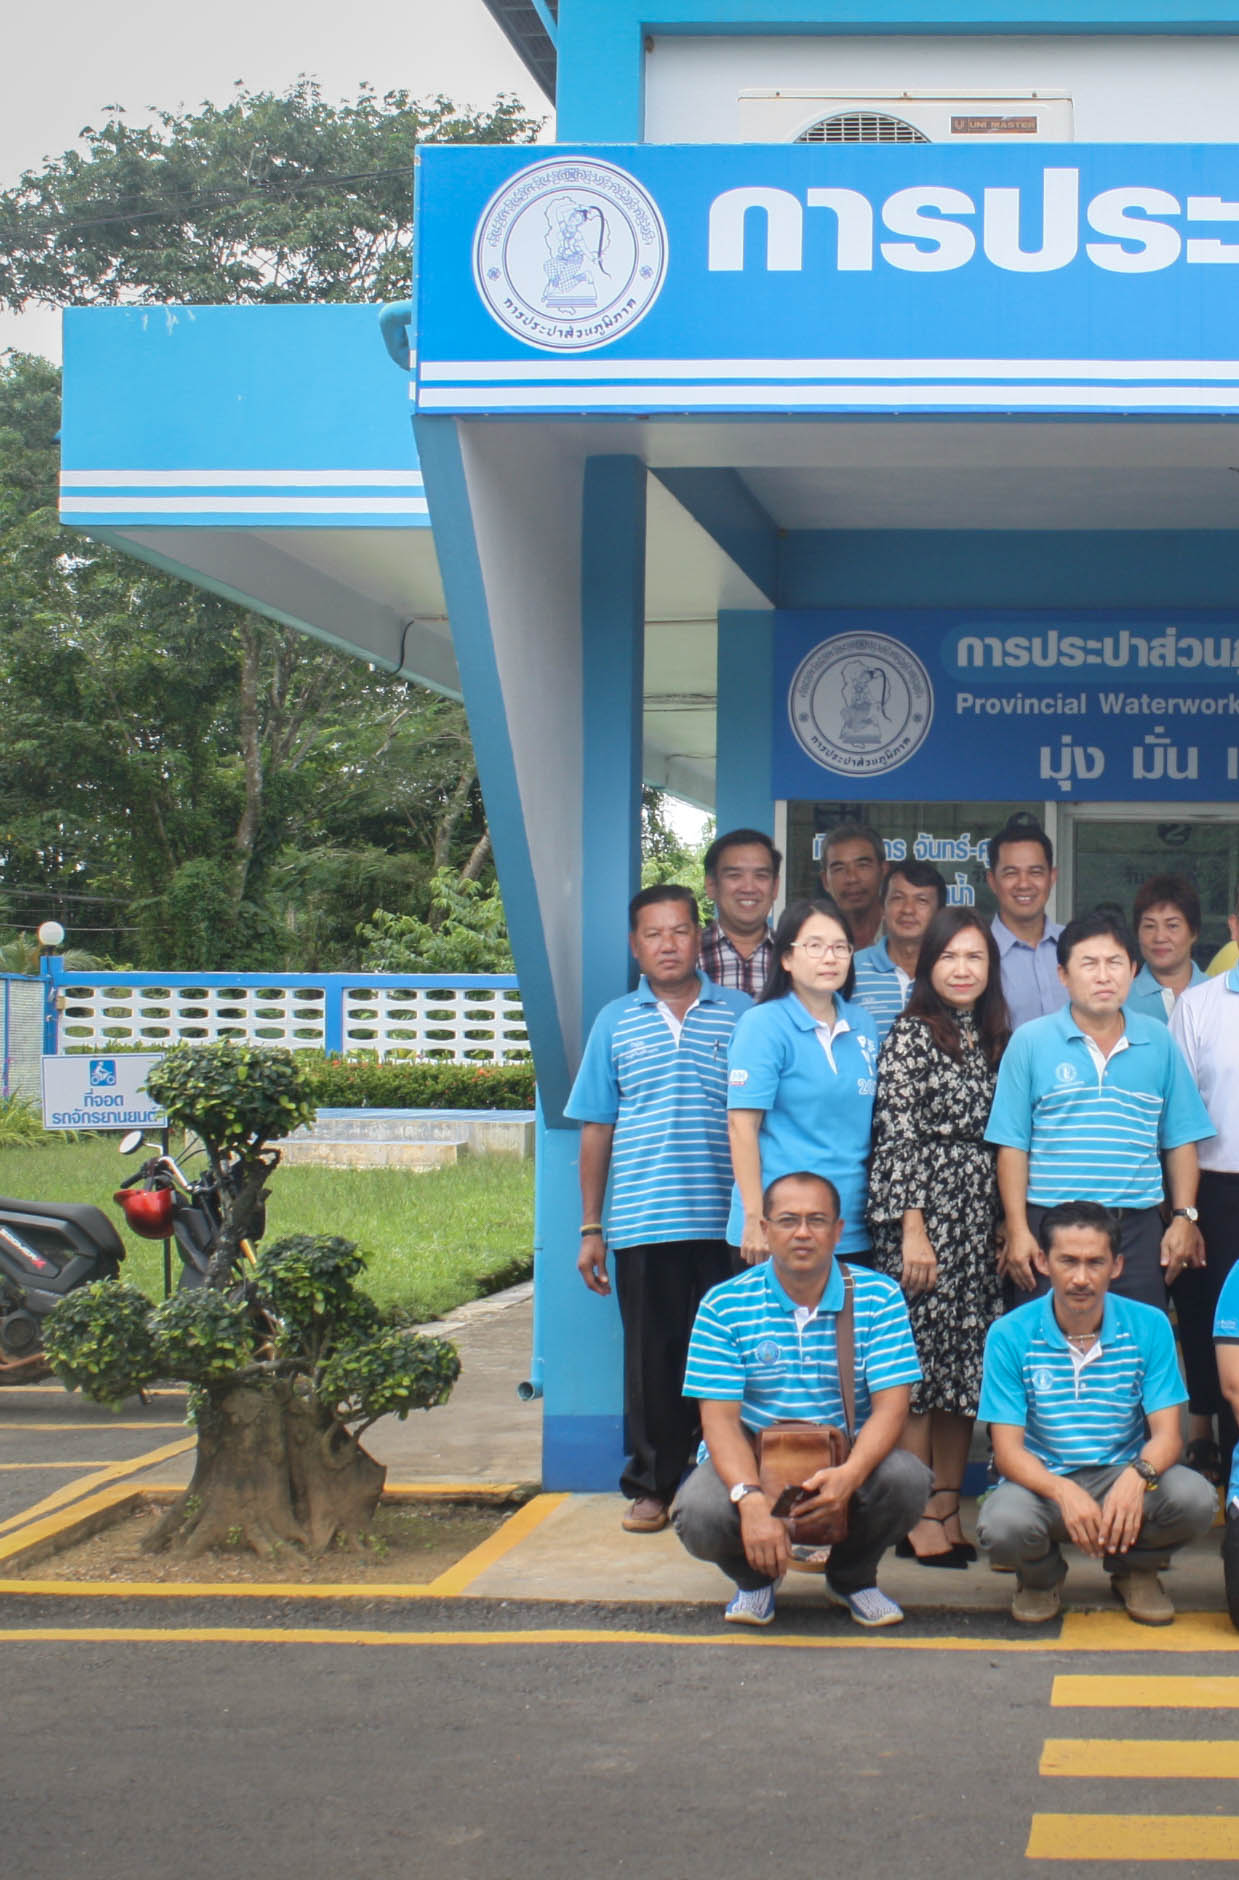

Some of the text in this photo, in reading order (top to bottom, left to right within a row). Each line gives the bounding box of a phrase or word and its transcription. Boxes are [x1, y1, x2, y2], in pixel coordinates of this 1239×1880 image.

[956, 693, 1087, 715] Provincial
[1040, 735, 1106, 791] มุ่ง
[1132, 726, 1199, 780] มั่น
[83, 1088, 125, 1107] ที่จอด
